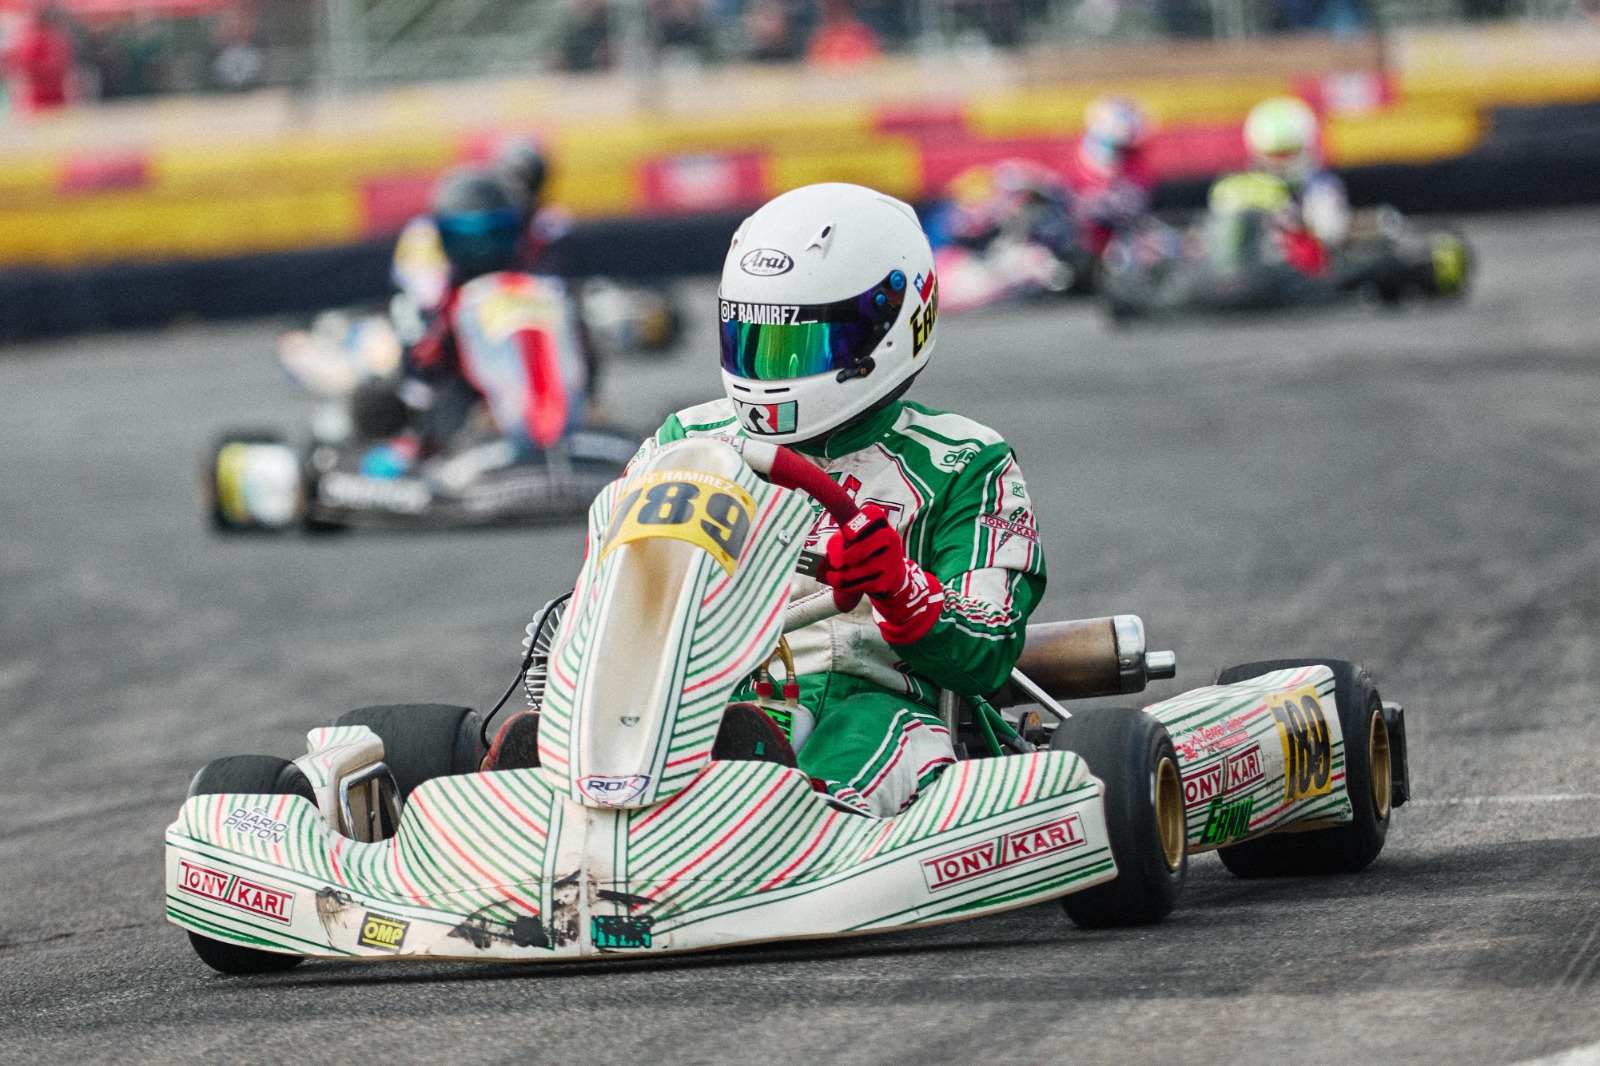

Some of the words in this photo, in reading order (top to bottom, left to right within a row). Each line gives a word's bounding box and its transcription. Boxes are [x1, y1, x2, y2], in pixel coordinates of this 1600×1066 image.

[741, 250, 787, 270] Arai
[660, 471, 735, 492] RAMIREZ
[586, 777, 640, 794] ROK
[1183, 767, 1222, 803] ONY
[1230, 745, 1261, 787] KART
[222, 816, 285, 843] PISTON
[231, 808, 288, 832] DIARIO
[924, 842, 995, 882] TONY
[1010, 815, 1078, 859] KART
[180, 861, 229, 897] TONY
[237, 880, 294, 916] KART
[364, 921, 404, 945] OMP
